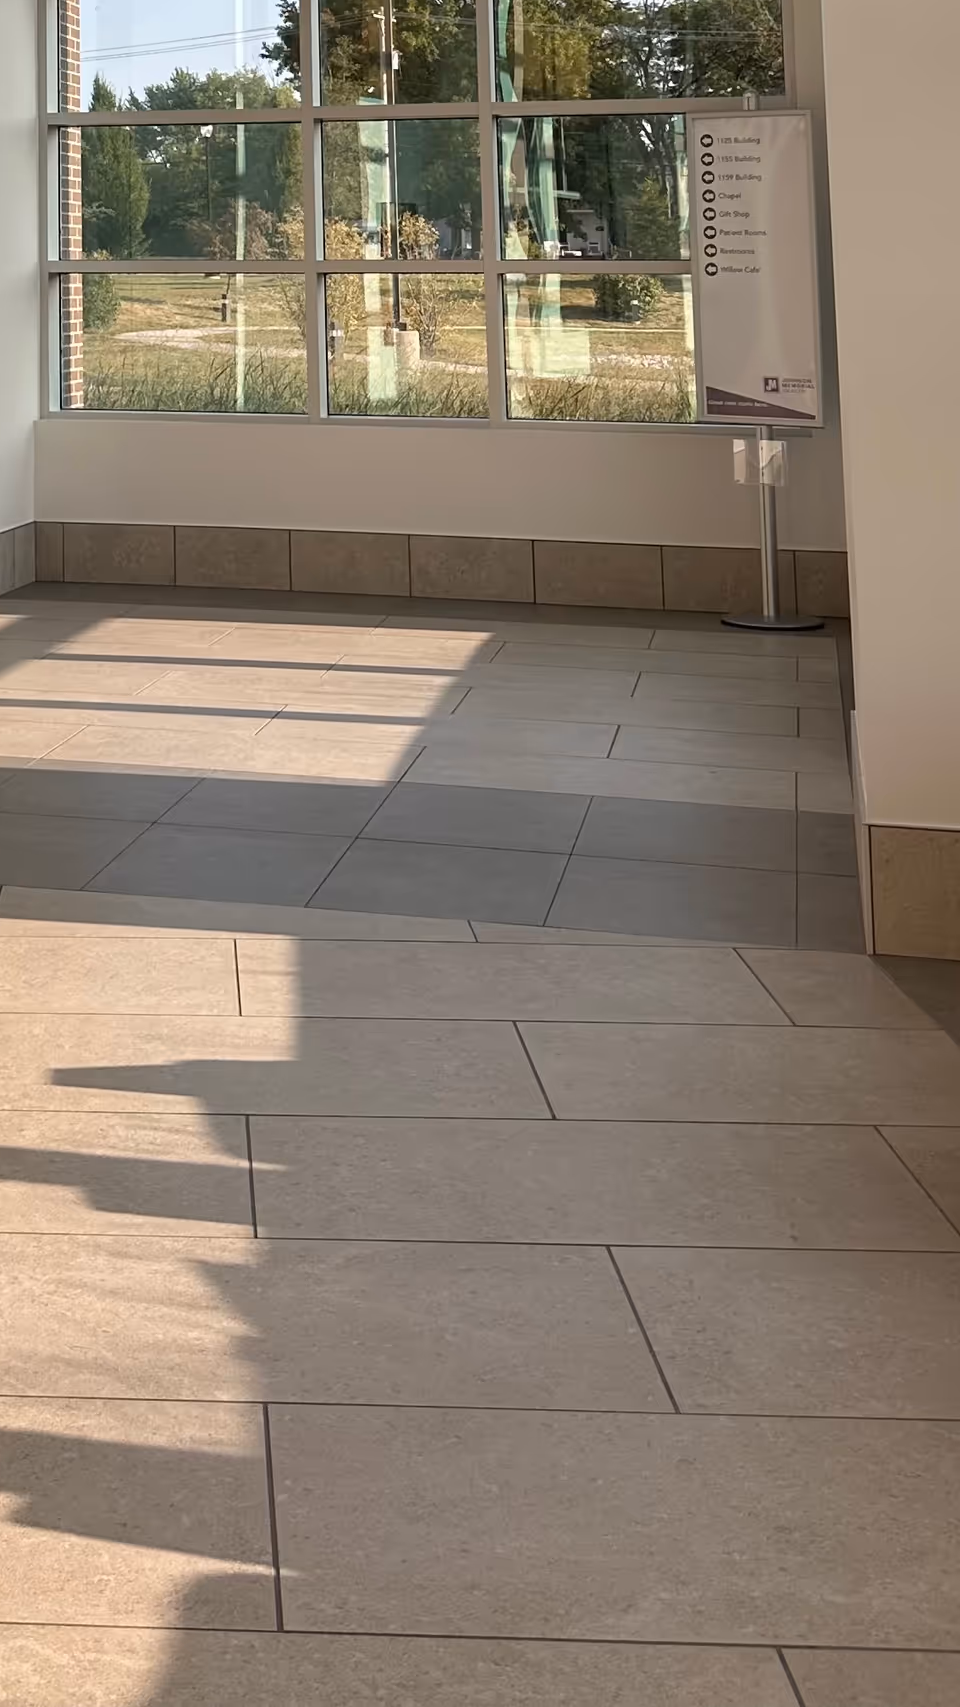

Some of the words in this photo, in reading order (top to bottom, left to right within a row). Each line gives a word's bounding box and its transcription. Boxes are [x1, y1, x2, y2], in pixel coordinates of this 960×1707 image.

[734, 137, 761, 145] Building
[734, 155, 761, 163] Building
[735, 173, 762, 182] Building
[718, 192, 742, 200] Chapel
[733, 210, 750, 219] Shop
[720, 247, 755, 255] Restrooms
